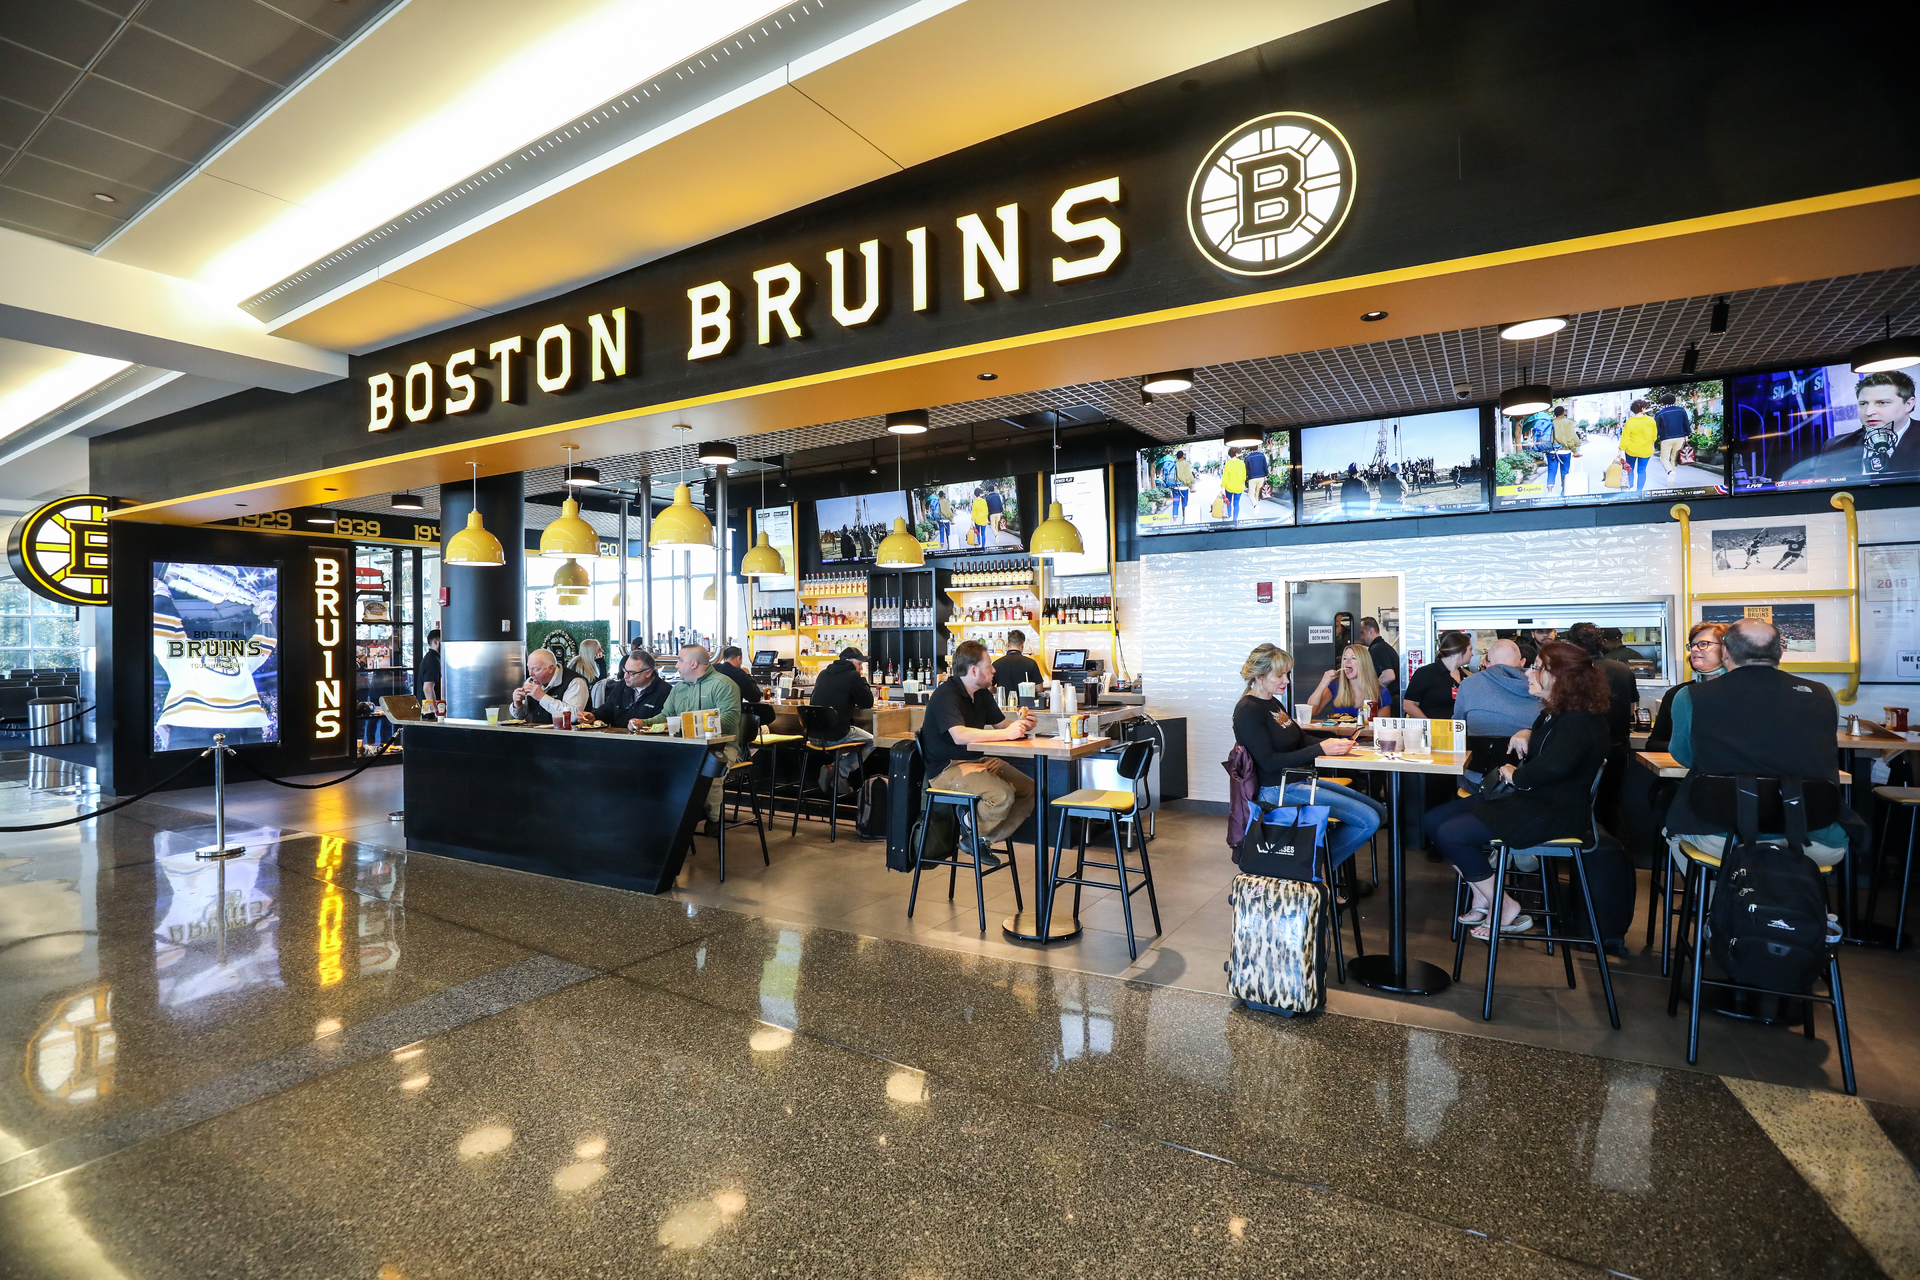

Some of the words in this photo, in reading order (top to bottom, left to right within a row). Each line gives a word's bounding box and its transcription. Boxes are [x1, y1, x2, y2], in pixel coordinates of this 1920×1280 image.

[367, 306, 626, 432] BOSTON
[687, 176, 1122, 361] BRUINS
[237, 511, 292, 530] 1929
[333, 517, 381, 538] 1939
[1877, 578, 1908, 589] 2019
[193, 630, 239, 639] BOSTON
[166, 640, 263, 658] BRUINS
[314, 557, 341, 739] BRUINS
